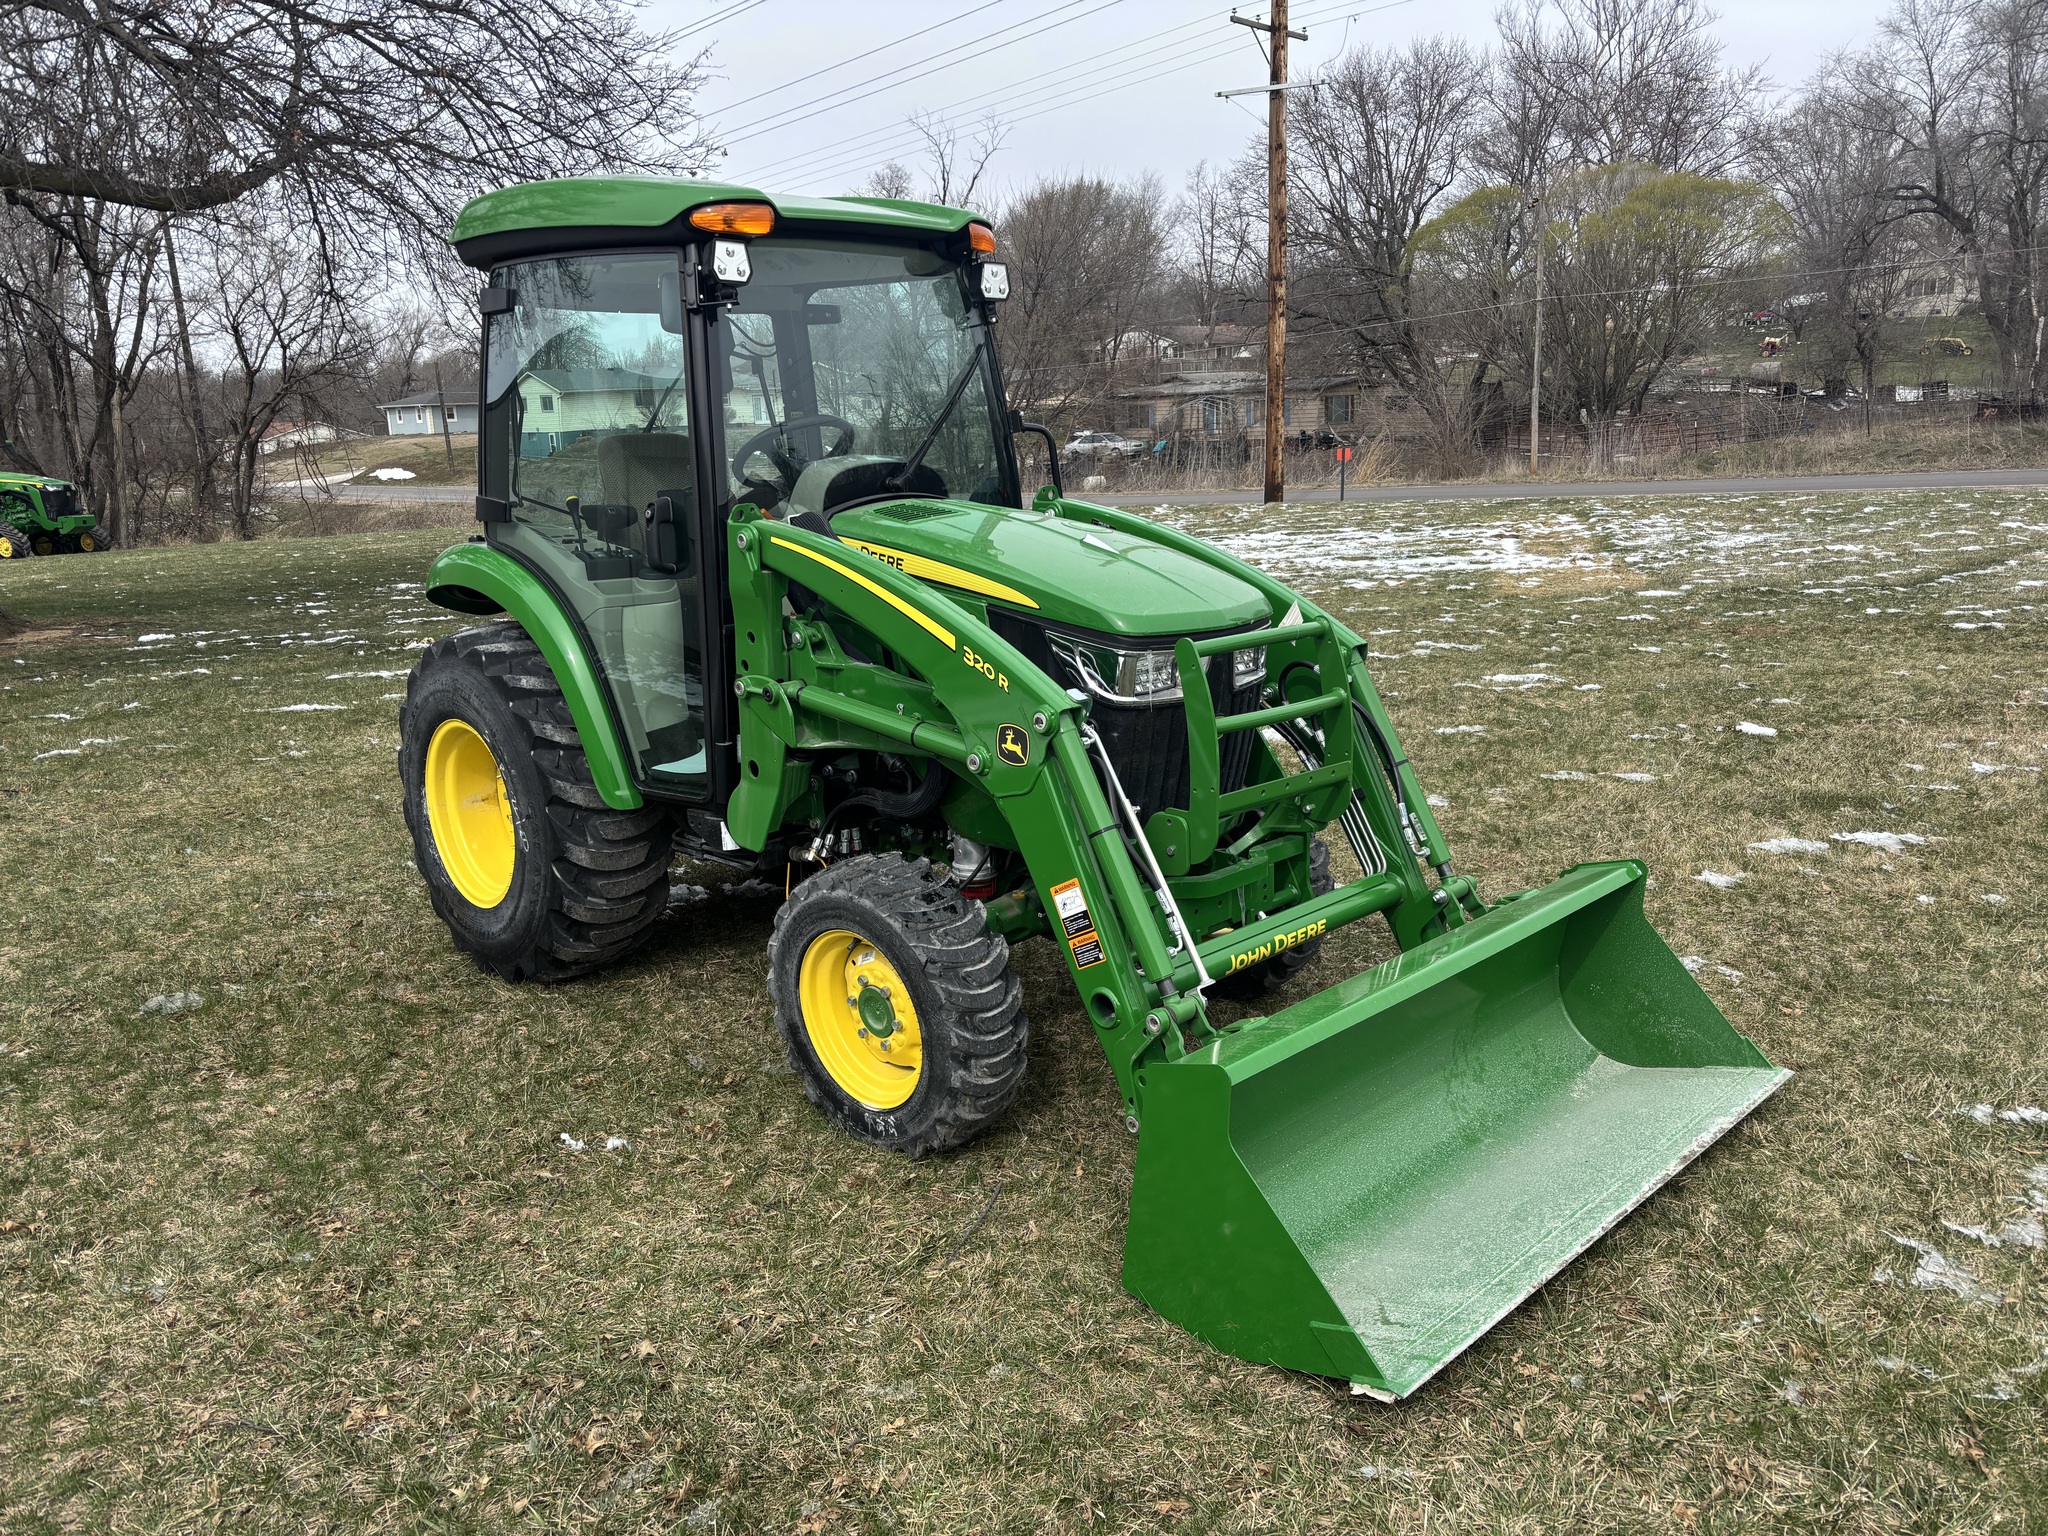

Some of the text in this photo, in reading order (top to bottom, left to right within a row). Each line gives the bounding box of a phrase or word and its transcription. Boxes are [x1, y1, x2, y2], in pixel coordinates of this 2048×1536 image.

[962, 645, 1010, 693] 320 R
[1225, 918, 1327, 975] JOHN DEERE
